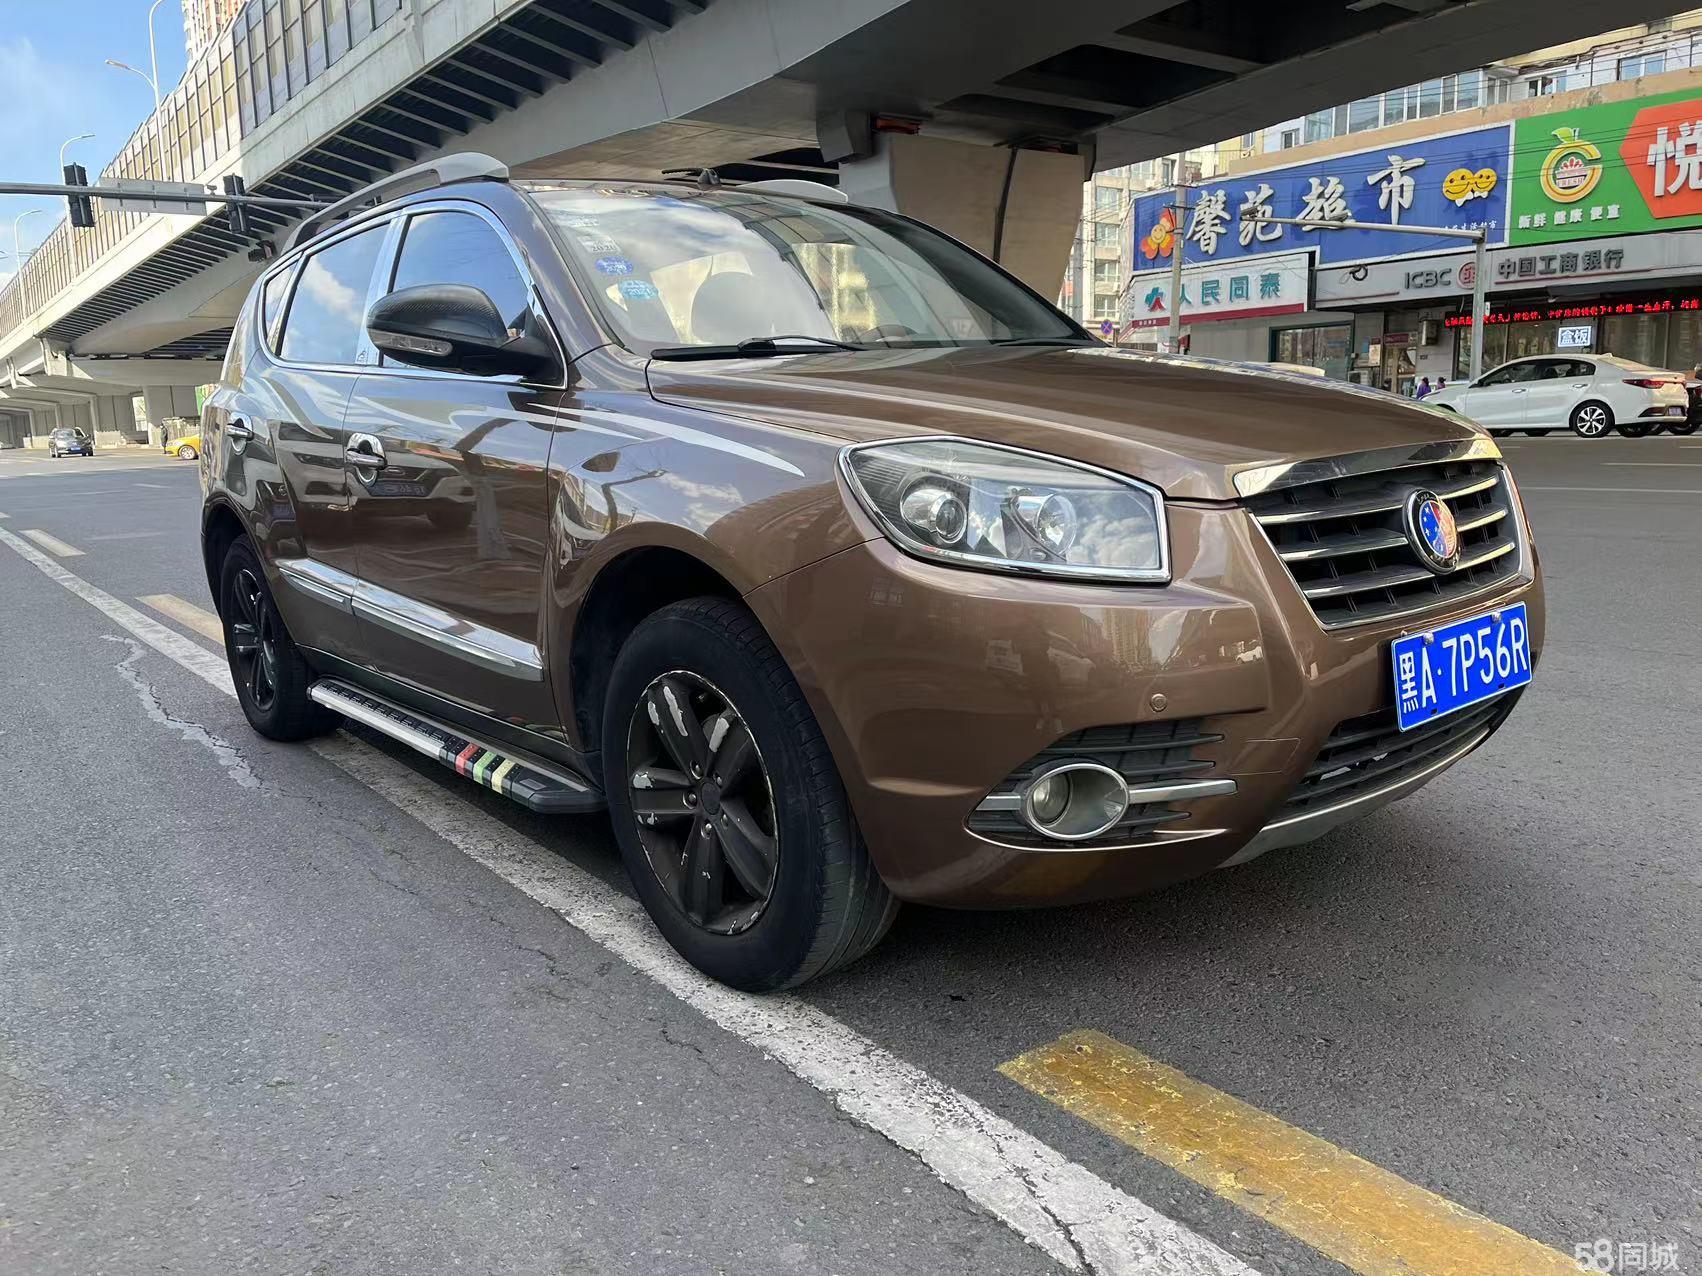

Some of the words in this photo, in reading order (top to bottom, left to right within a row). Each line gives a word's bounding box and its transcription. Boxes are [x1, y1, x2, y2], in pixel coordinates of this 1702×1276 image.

[1186, 154, 1427, 255] 馨苑超市
[1518, 212, 1547, 229] 新鲜
[1590, 204, 1620, 220] 便宜
[1404, 268, 1453, 290] ICBC
[1498, 248, 1624, 280] 中国工商银行
[1179, 272, 1281, 306] 人民同泰
[1560, 329, 1588, 345] 盒饭
[1399, 616, 1528, 714] 黑A·7P56R
